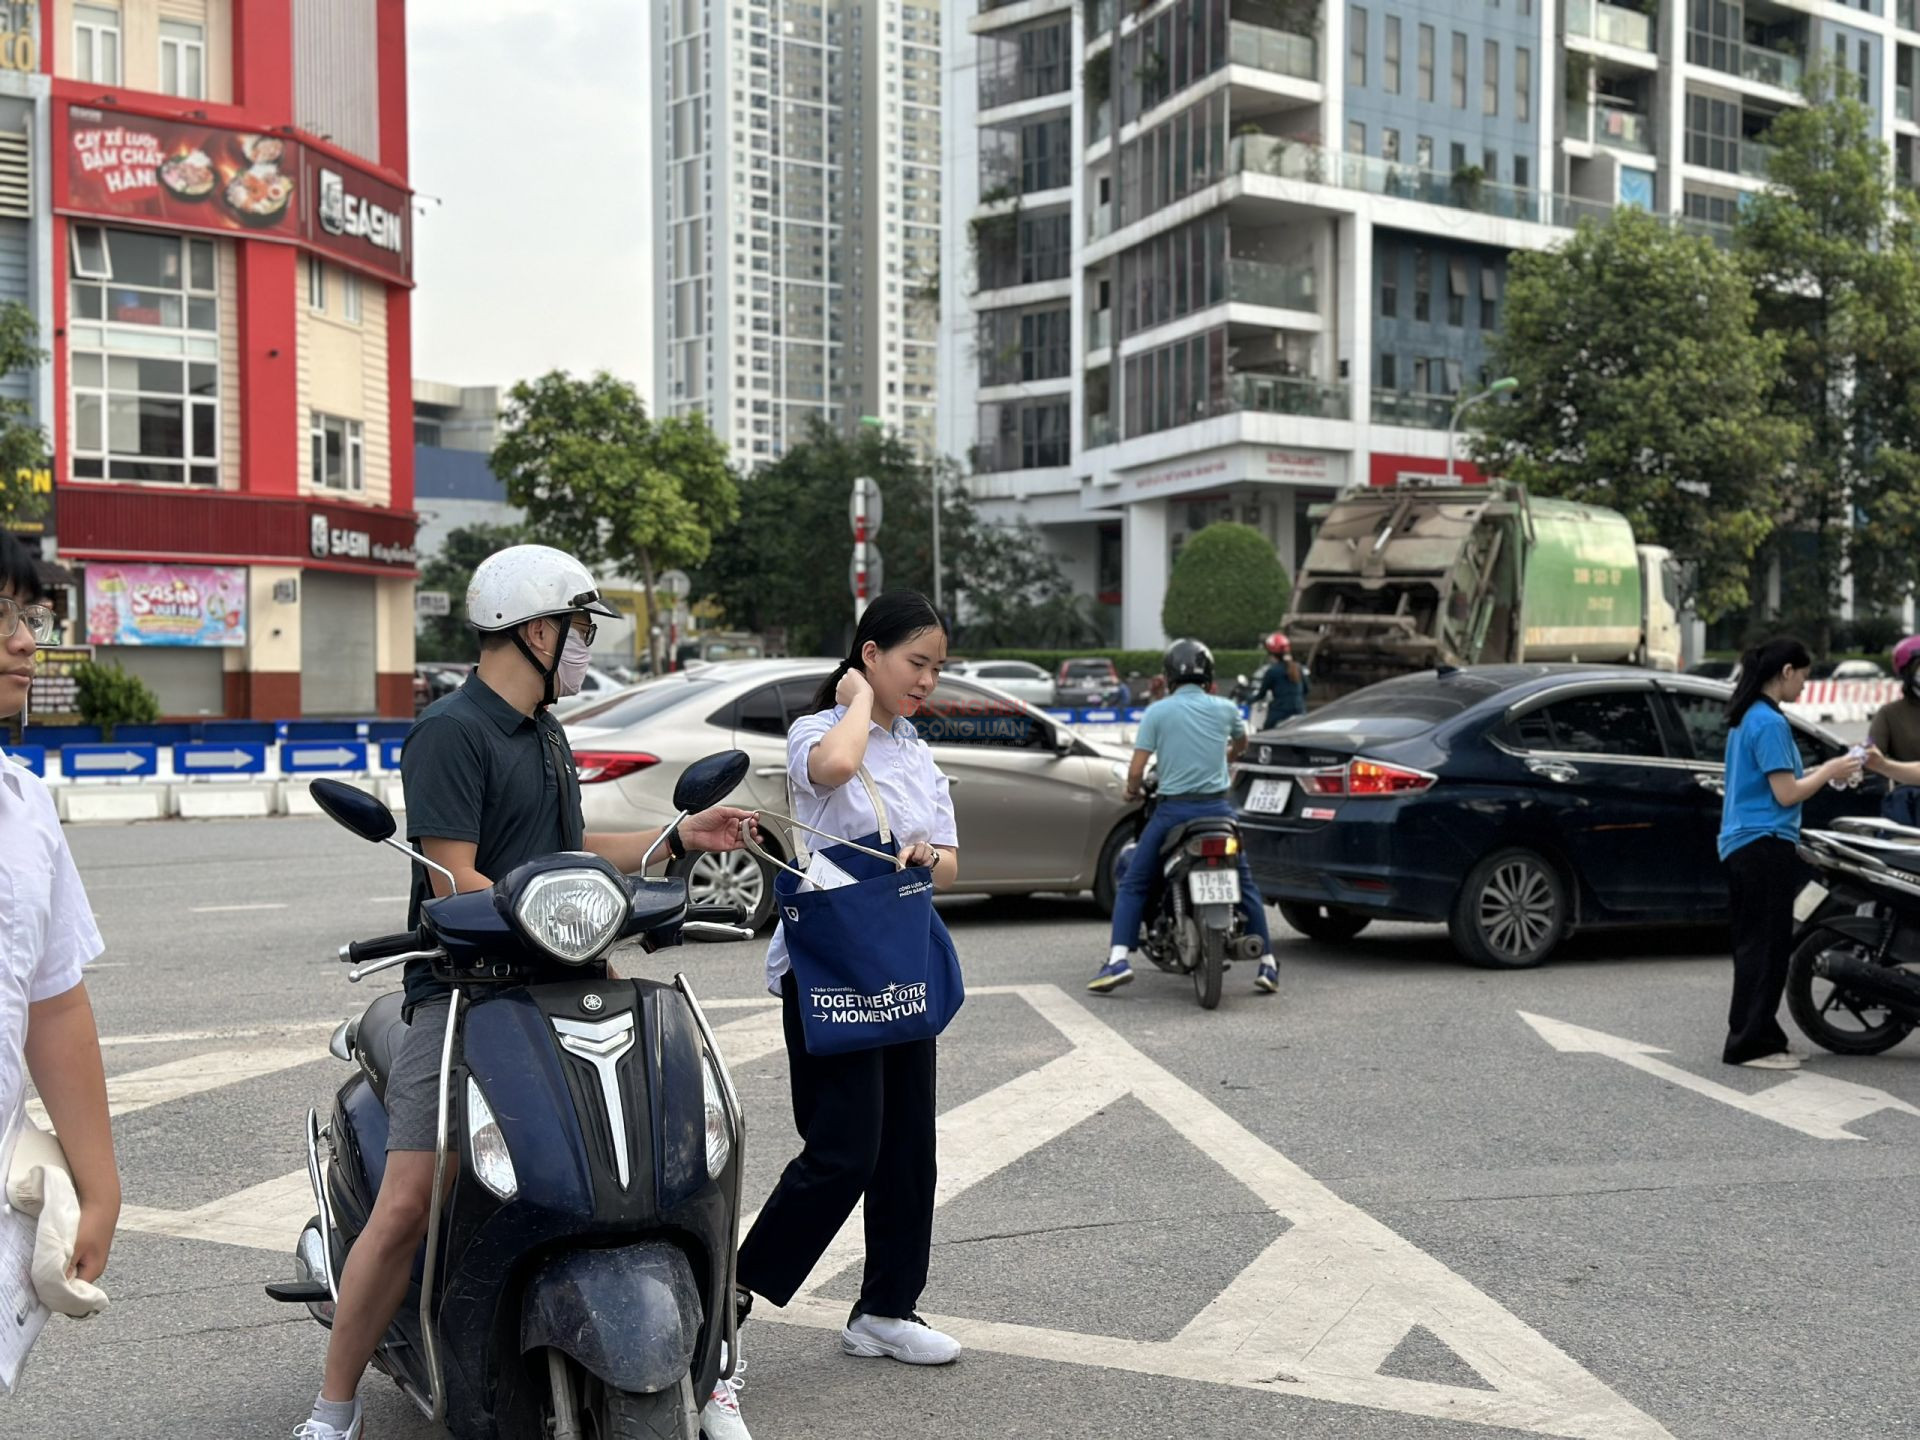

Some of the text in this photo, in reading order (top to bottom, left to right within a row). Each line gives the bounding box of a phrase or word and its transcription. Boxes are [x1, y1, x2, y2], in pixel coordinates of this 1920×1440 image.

[344, 193, 401, 252] SASIN
[331, 529, 370, 558] SASIN
[810, 992, 895, 1009] TOGETHER
[832, 998, 927, 1023] MOMENTUM
